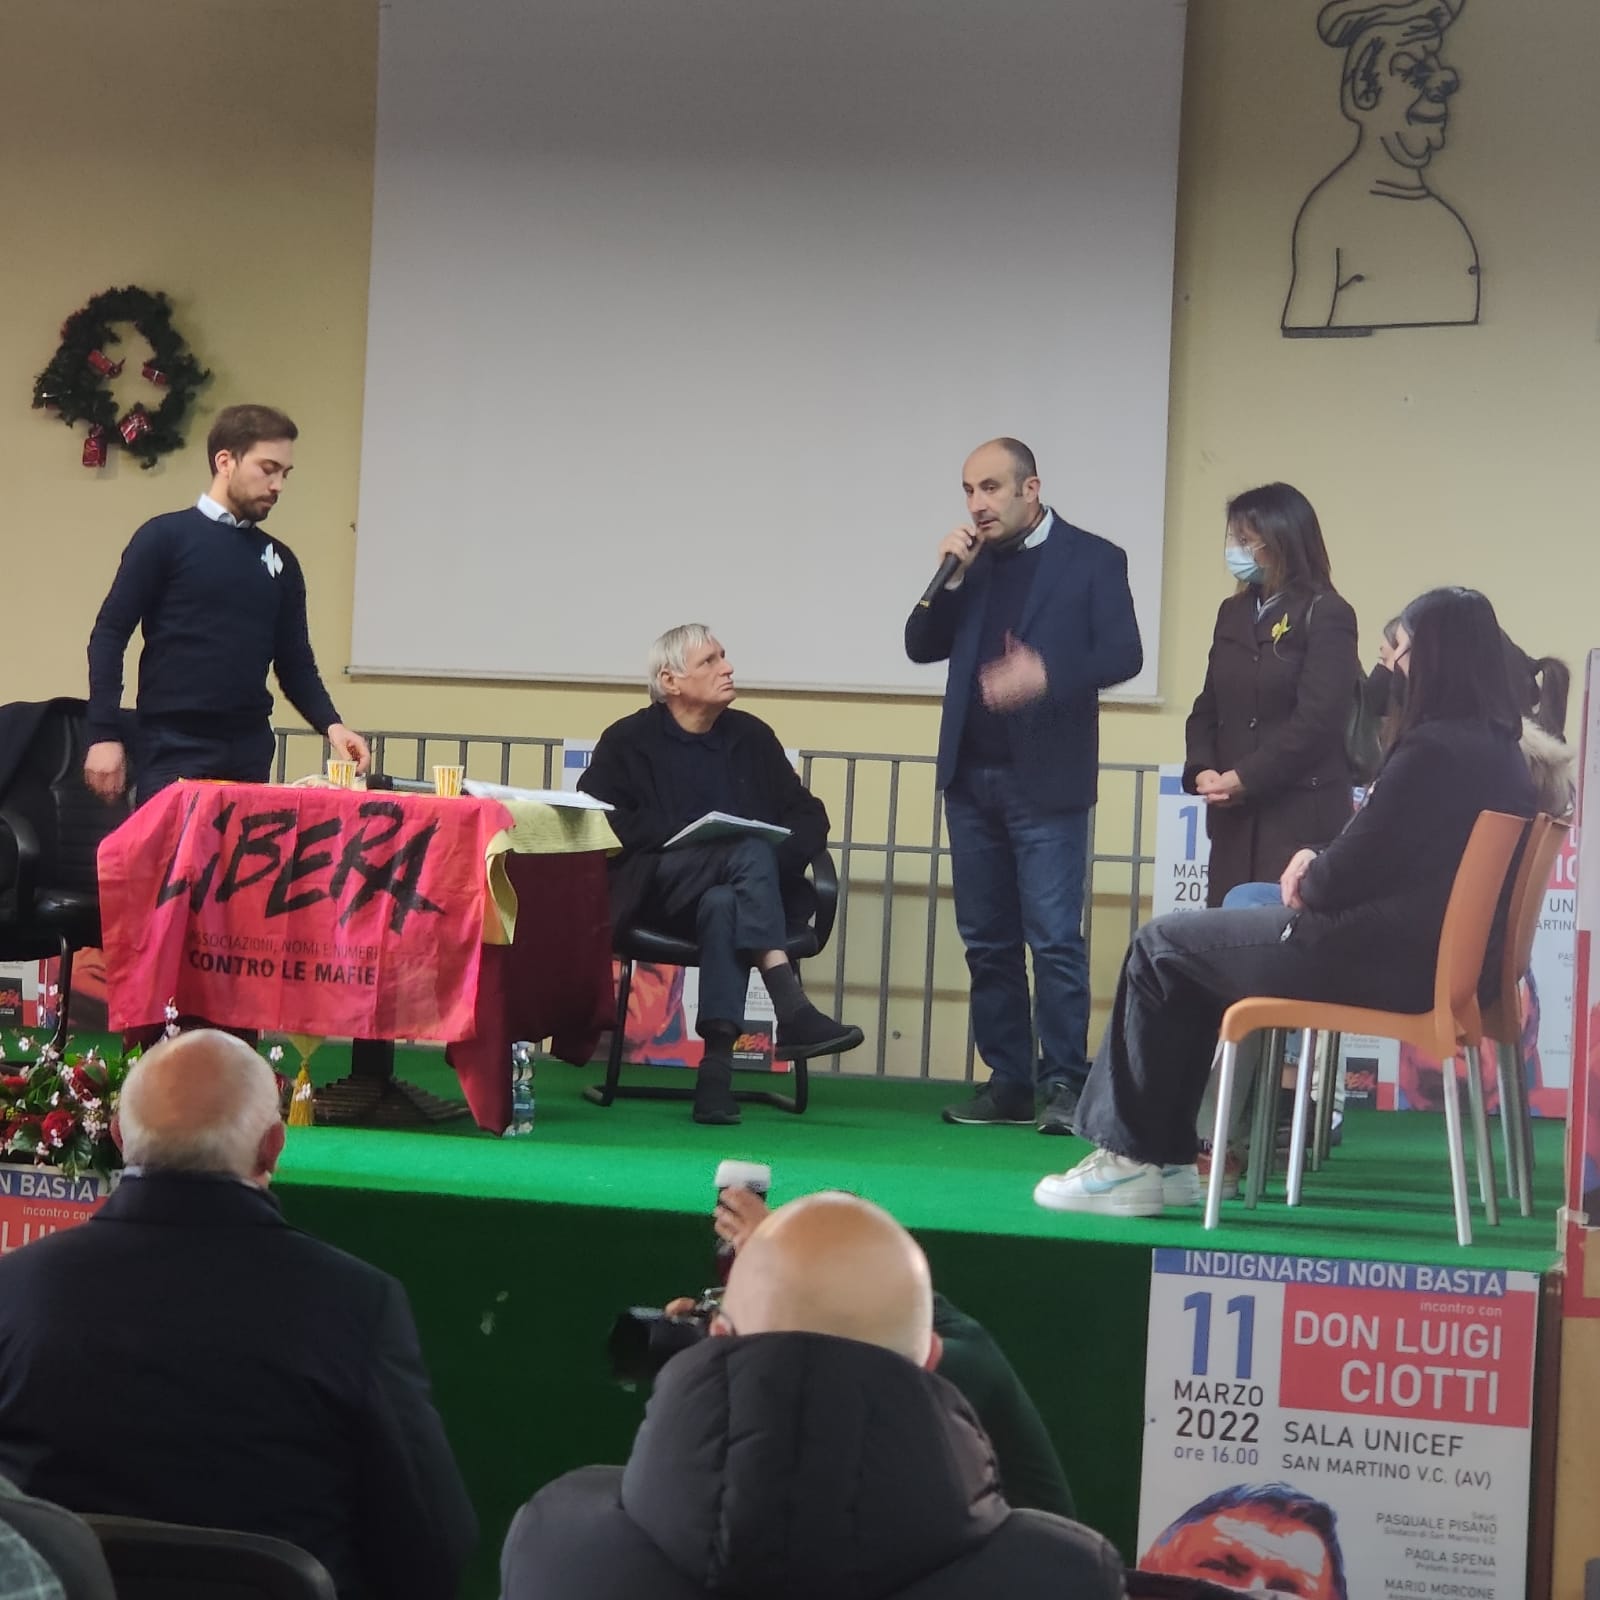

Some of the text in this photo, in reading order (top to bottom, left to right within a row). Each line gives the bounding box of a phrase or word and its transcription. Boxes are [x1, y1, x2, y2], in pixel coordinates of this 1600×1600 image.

[156, 791, 446, 935] LIBERA
[1173, 863, 1209, 879] MAR
[1174, 881, 1209, 902] 20
[189, 950, 376, 985] CONTRO LE MAFIE
[23, 1205, 94, 1221] incontro con
[1348, 1262, 1407, 1289] NON
[1415, 1267, 1503, 1296] BASTA
[1420, 1300, 1503, 1317] incontro con
[1183, 1291, 1256, 1380] 11
[1294, 1310, 1502, 1360] DON LUIGI
[1174, 1379, 1264, 1407] MARZO
[1340, 1360, 1499, 1414] CIOTTI
[1175, 1406, 1260, 1444] 2022
[1284, 1421, 1464, 1458] SALA UNICEF
[1173, 1446, 1259, 1466] ore 16.00
[1282, 1454, 1492, 1490] SAN MARTINO V.C. (AV)
[1376, 1512, 1497, 1535] PASQUALE PISANO
[1404, 1547, 1496, 1567] PAOLA SPENA
[1384, 1579, 1427, 1593] MARIO
[1430, 1583, 1496, 1600] MORCONE
